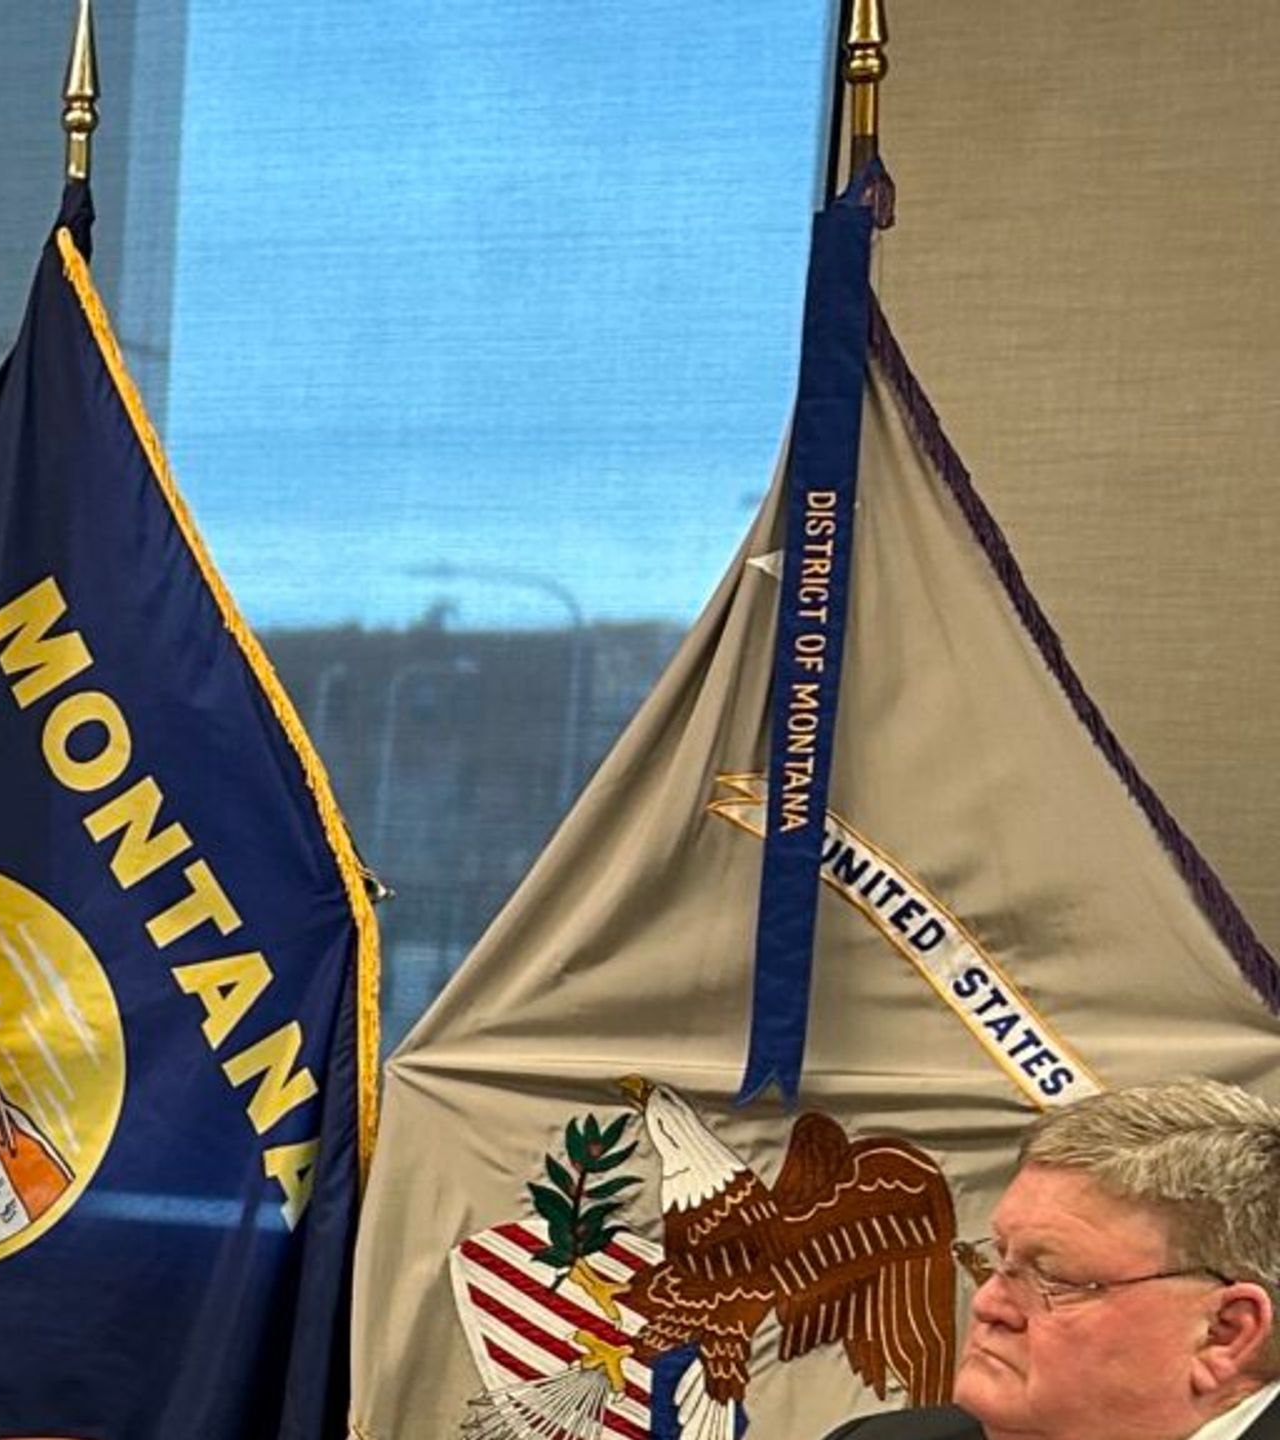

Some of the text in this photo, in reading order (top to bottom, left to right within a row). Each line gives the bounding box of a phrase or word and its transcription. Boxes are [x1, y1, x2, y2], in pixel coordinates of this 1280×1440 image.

[780, 491, 836, 833] DISTRICT OF MONTANA
[953, 966, 1074, 1097] STATES
